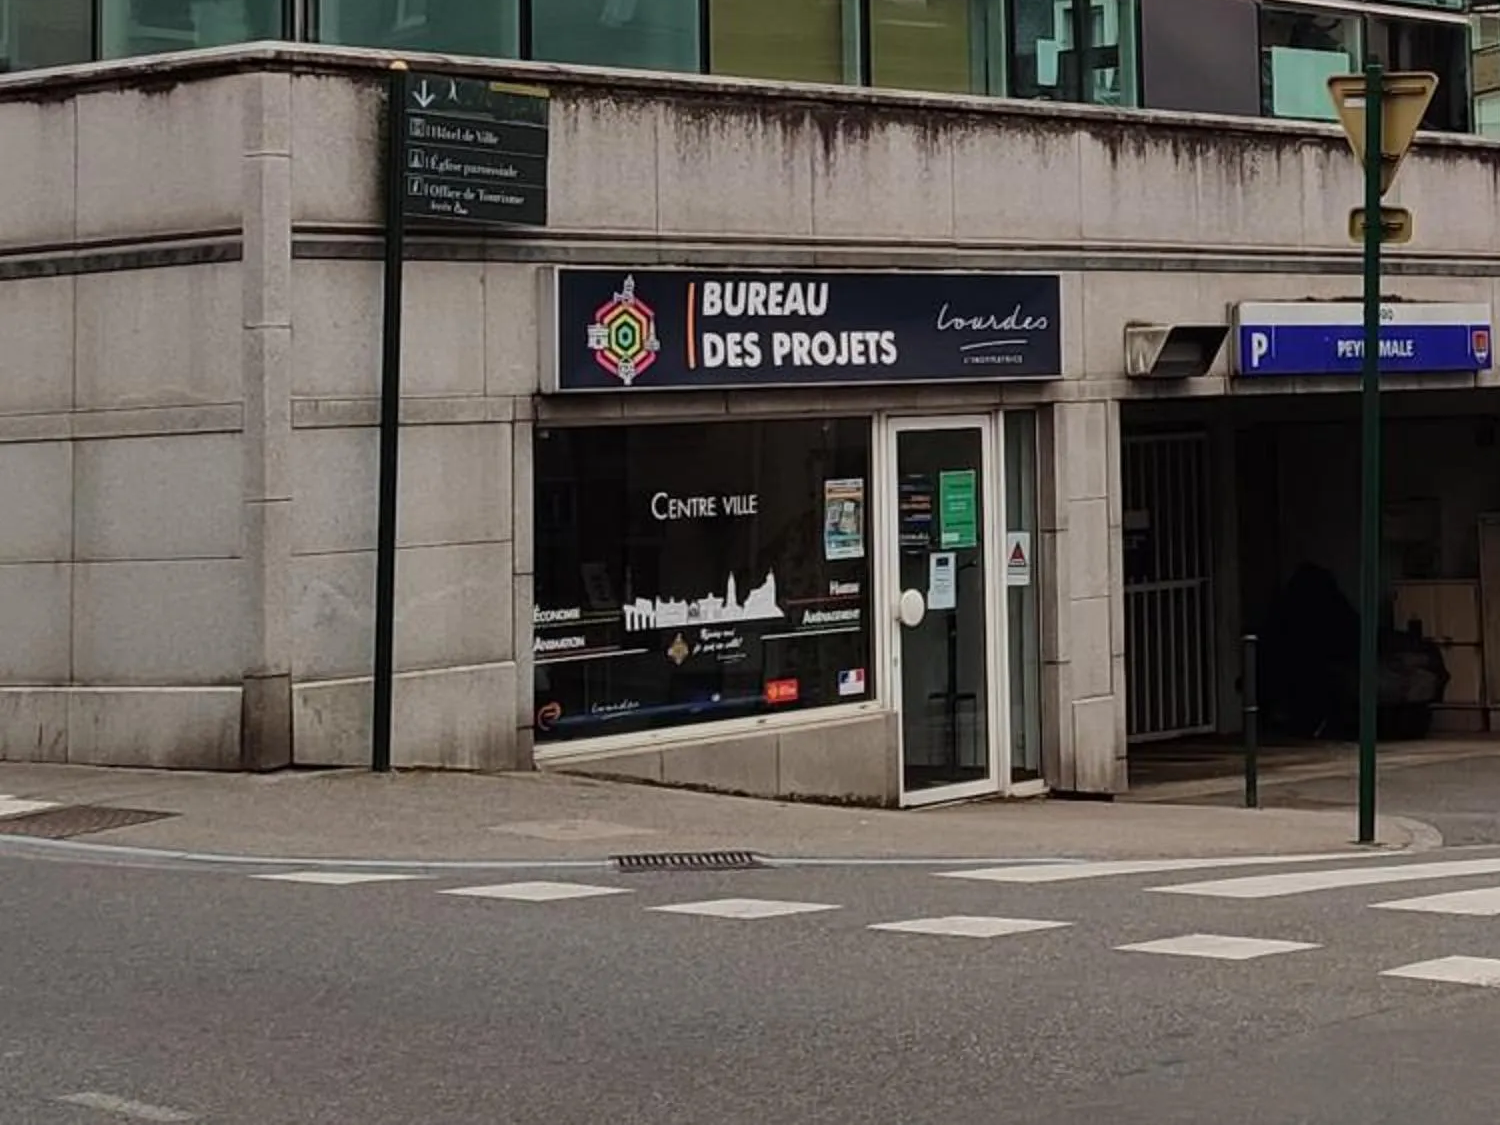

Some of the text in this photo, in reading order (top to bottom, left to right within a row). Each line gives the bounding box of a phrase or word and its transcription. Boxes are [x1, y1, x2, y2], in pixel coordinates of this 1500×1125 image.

[702, 281, 829, 317] BUREAU
[702, 330, 898, 368] DES PROJETS
[1251, 332, 1268, 368] P
